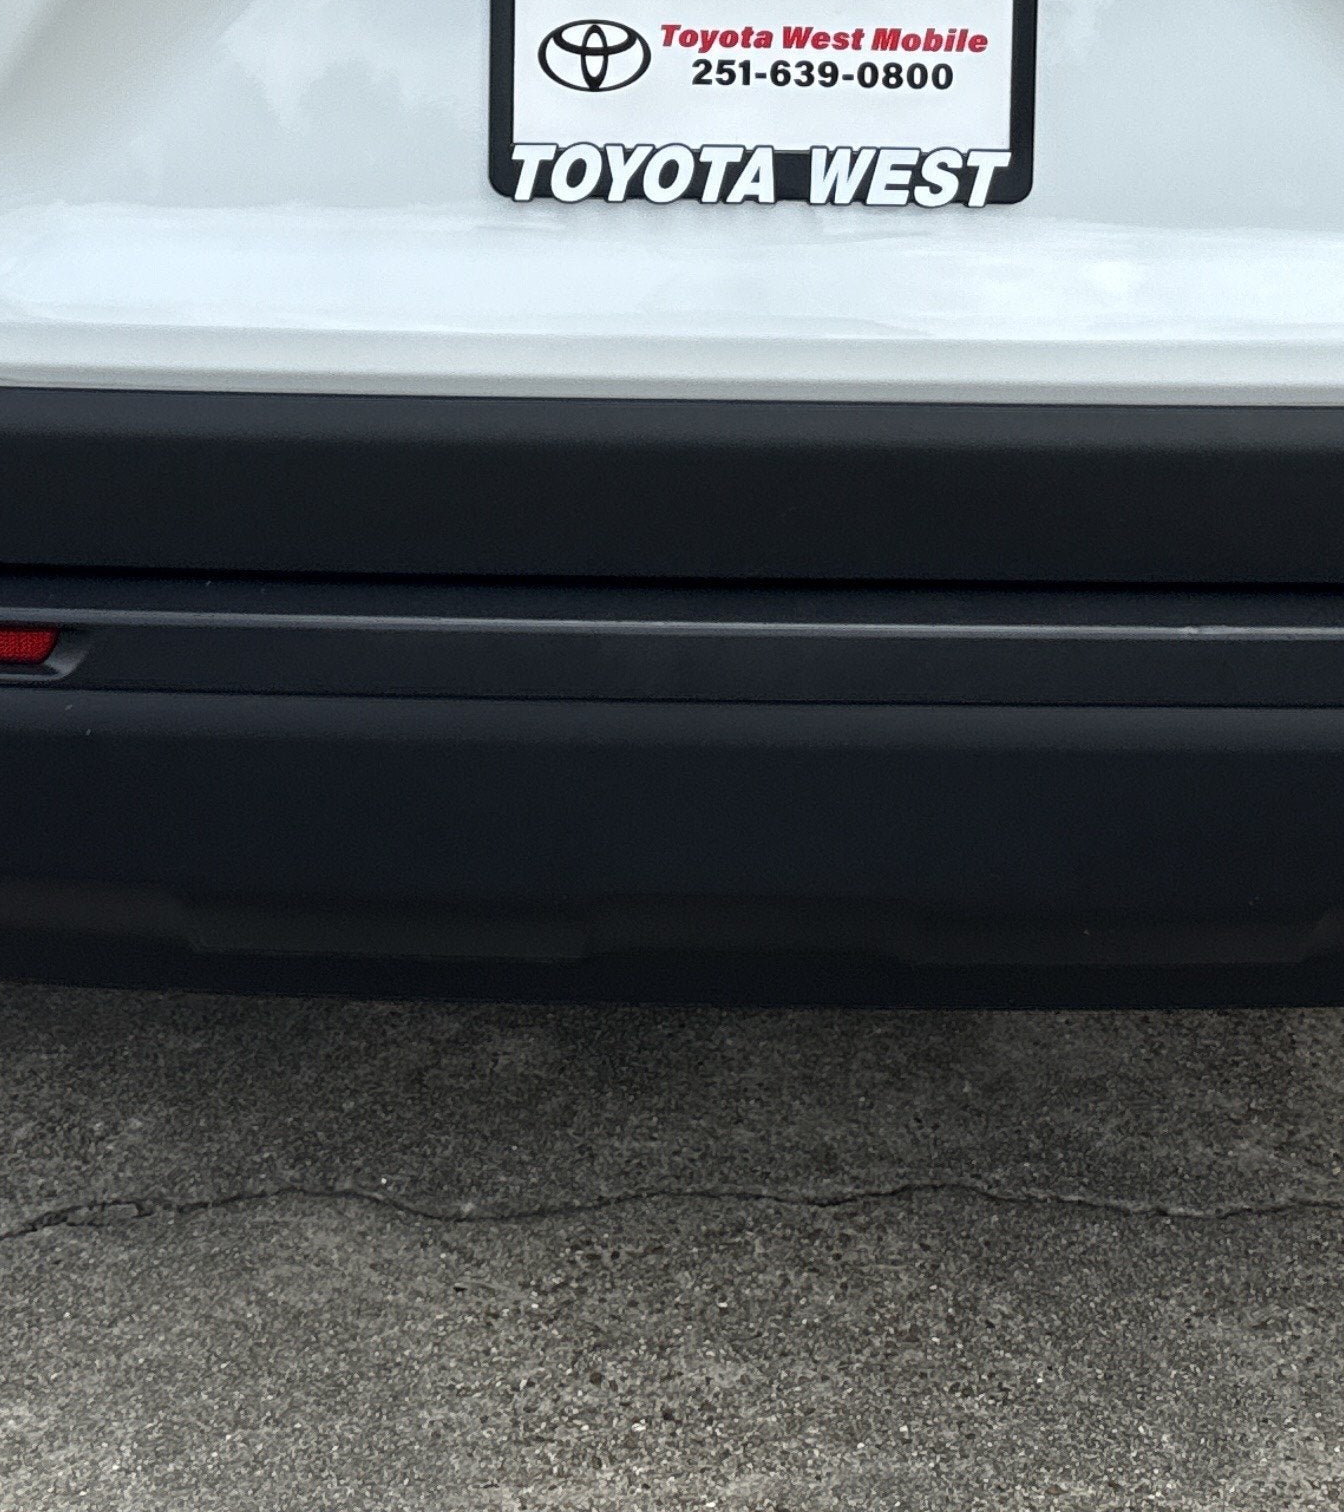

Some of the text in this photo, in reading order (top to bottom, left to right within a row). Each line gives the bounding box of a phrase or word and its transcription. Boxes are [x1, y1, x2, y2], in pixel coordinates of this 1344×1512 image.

[660, 24, 989, 54] Toyota West Mobile
[691, 58, 955, 90] 251-639-0800
[510, 143, 1012, 208] TOYOTA WEST
